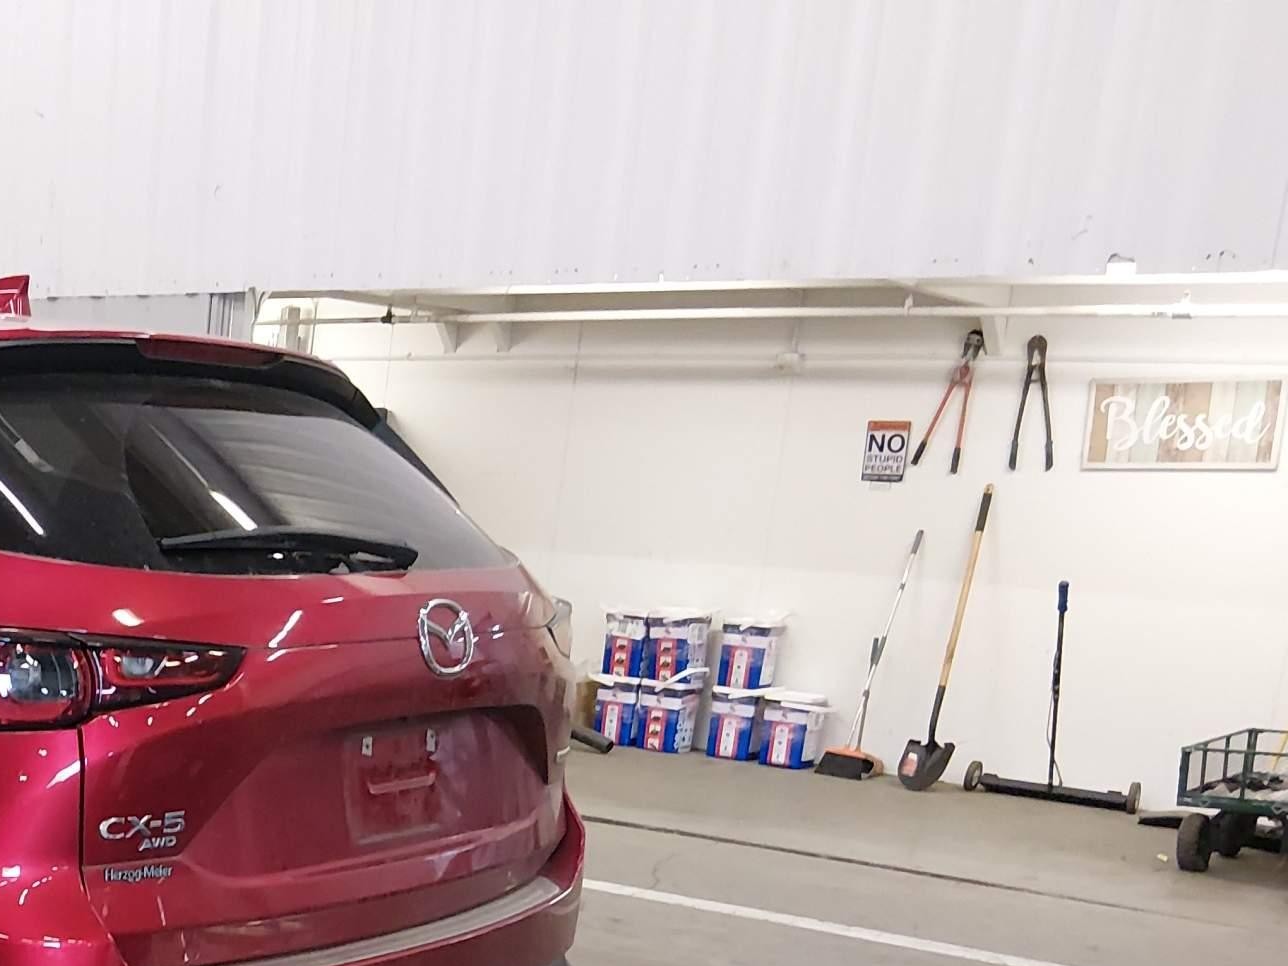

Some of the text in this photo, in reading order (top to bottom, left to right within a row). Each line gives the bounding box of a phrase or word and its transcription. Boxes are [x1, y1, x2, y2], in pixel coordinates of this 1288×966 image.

[1100, 395, 1272, 450] Blessed
[868, 433, 905, 453] NO
[866, 454, 903, 464] STUPID
[864, 464, 901, 473] PEOPLE
[99, 810, 186, 840] CX-5
[137, 835, 177, 852] AWD
